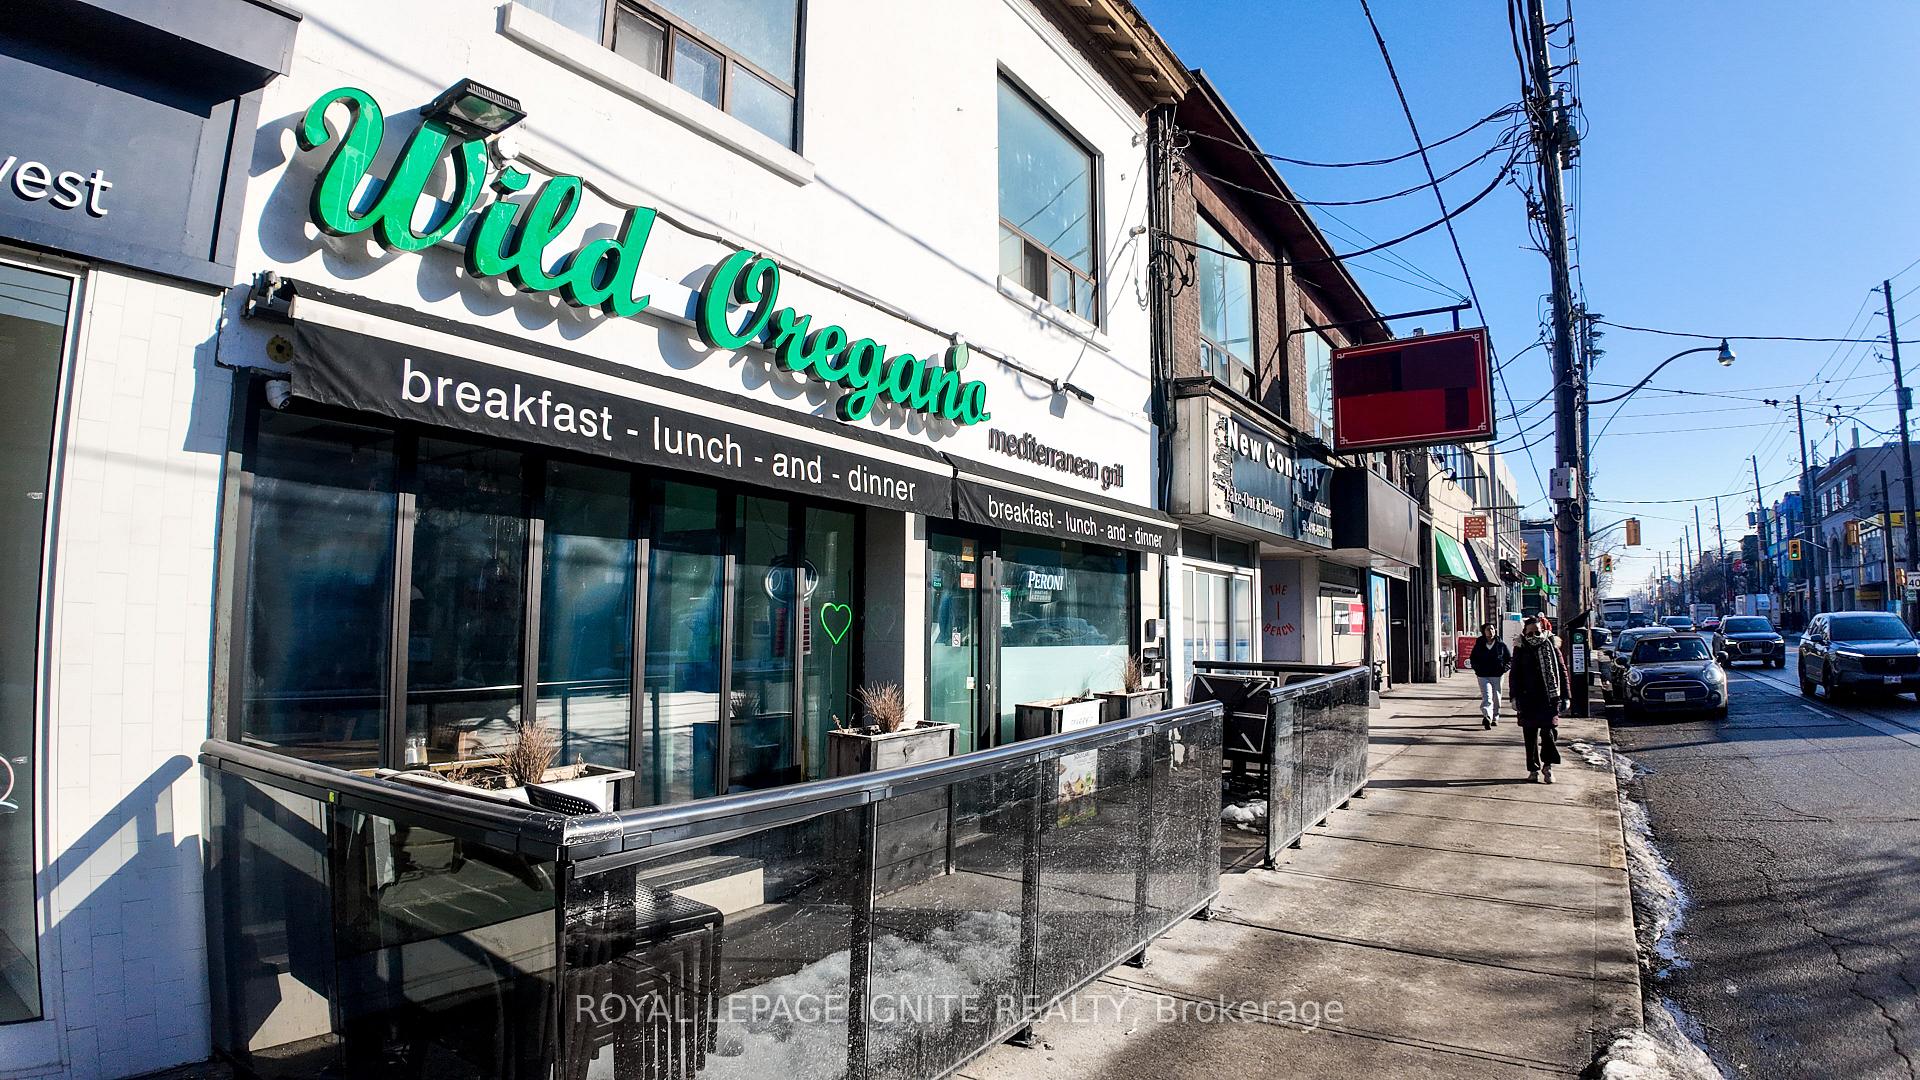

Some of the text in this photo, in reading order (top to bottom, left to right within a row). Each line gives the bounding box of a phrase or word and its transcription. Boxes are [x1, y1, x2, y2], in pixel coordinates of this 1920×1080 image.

[296, 87, 991, 425] Wild Oregano
[402, 358, 613, 441] breakfast
[653, 416, 743, 468] lunch
[772, 452, 822, 484] and
[848, 464, 916, 502] dinner
[1225, 417, 1262, 464] New
[1265, 441, 1319, 492] Concept
[988, 427, 1124, 491] mediterranean grill
[988, 494, 1055, 529] breakfast
[1065, 511, 1097, 537] lunch
[1107, 523, 1126, 542] and
[1135, 526, 1162, 548] dinner
[1261, 498, 1284, 522] Delivery
[1027, 570, 1064, 591] PERONI
[1269, 583, 1288, 596] THE
[1263, 622, 1296, 637] BEACH
